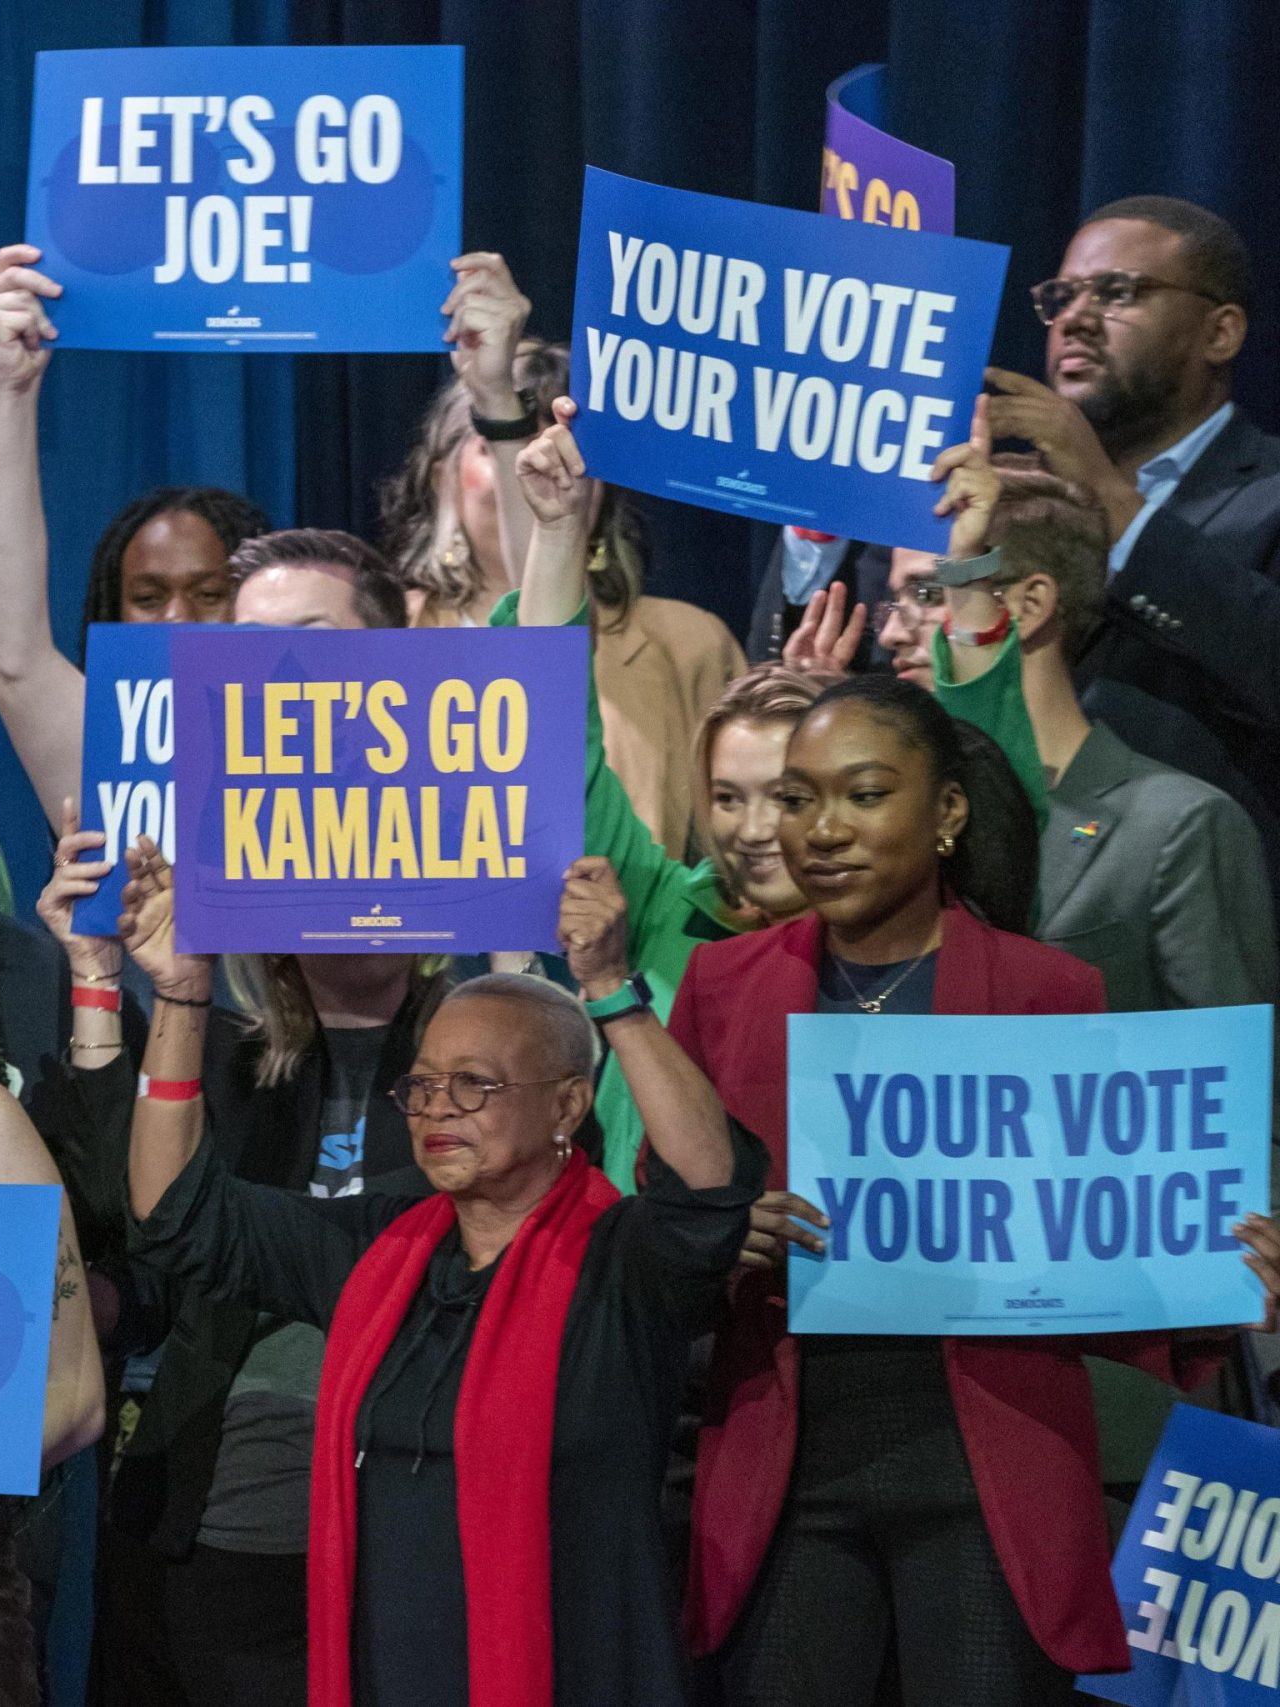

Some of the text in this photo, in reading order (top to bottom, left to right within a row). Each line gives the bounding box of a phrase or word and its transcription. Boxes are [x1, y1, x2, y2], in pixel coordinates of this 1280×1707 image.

[78, 94, 402, 185] LET'S GO
[154, 195, 313, 283] JOE!
[608, 231, 956, 378] YOUR VOTE
[585, 327, 954, 481] YOUR VOICE
[225, 678, 528, 775] LET'S GO
[224, 785, 528, 880] KAMALA!
[835, 1066, 1227, 1159] YOUR VOTE
[817, 1169, 1244, 1263] YOUR VOICE
[1141, 1470, 1280, 1583] OICE
